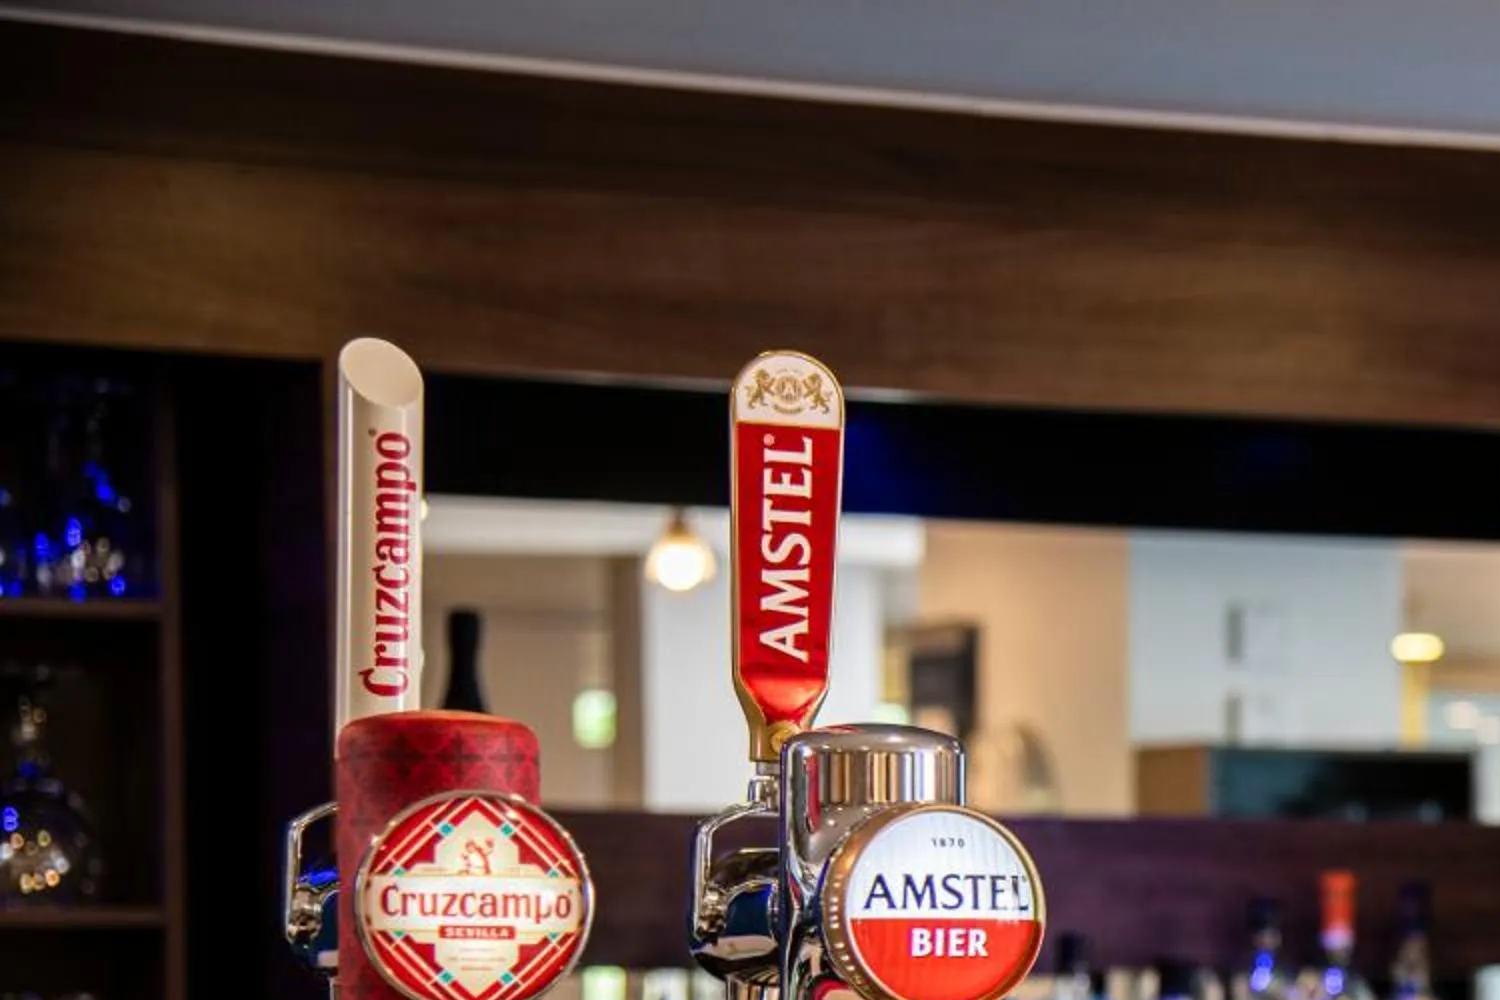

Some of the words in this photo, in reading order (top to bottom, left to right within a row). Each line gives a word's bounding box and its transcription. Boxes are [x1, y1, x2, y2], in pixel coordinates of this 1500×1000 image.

[359, 431, 417, 697] Cruzcampo
[759, 436, 813, 663] AMSTEL
[931, 837, 965, 849] 1870
[380, 882, 572, 924] Cruzcampo
[863, 873, 1029, 911] AMSTEL
[444, 926, 511, 939] SEVILLA
[911, 927, 989, 957] BIER
